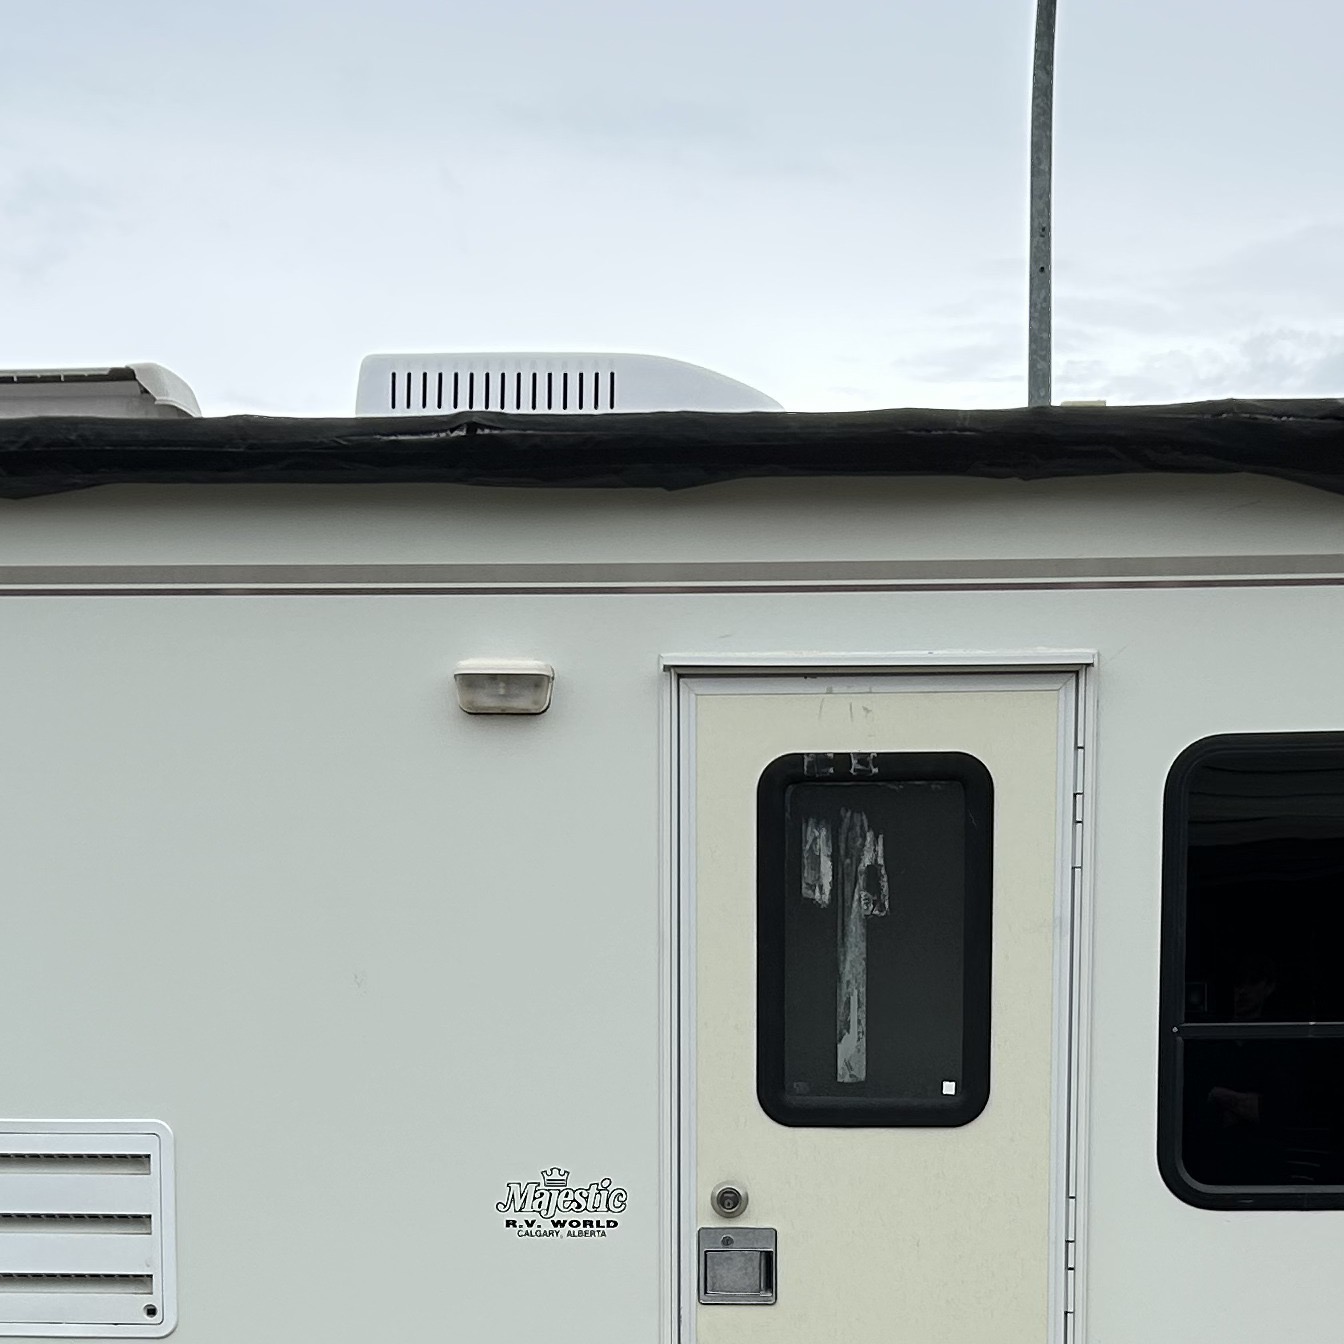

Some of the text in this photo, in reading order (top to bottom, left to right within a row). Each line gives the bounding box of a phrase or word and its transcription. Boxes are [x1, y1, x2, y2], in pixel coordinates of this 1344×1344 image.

[495, 1177, 628, 1219] Majestic
[505, 1219, 619, 1229] R.V. WORLD
[566, 1229, 607, 1239] ALBERTA
